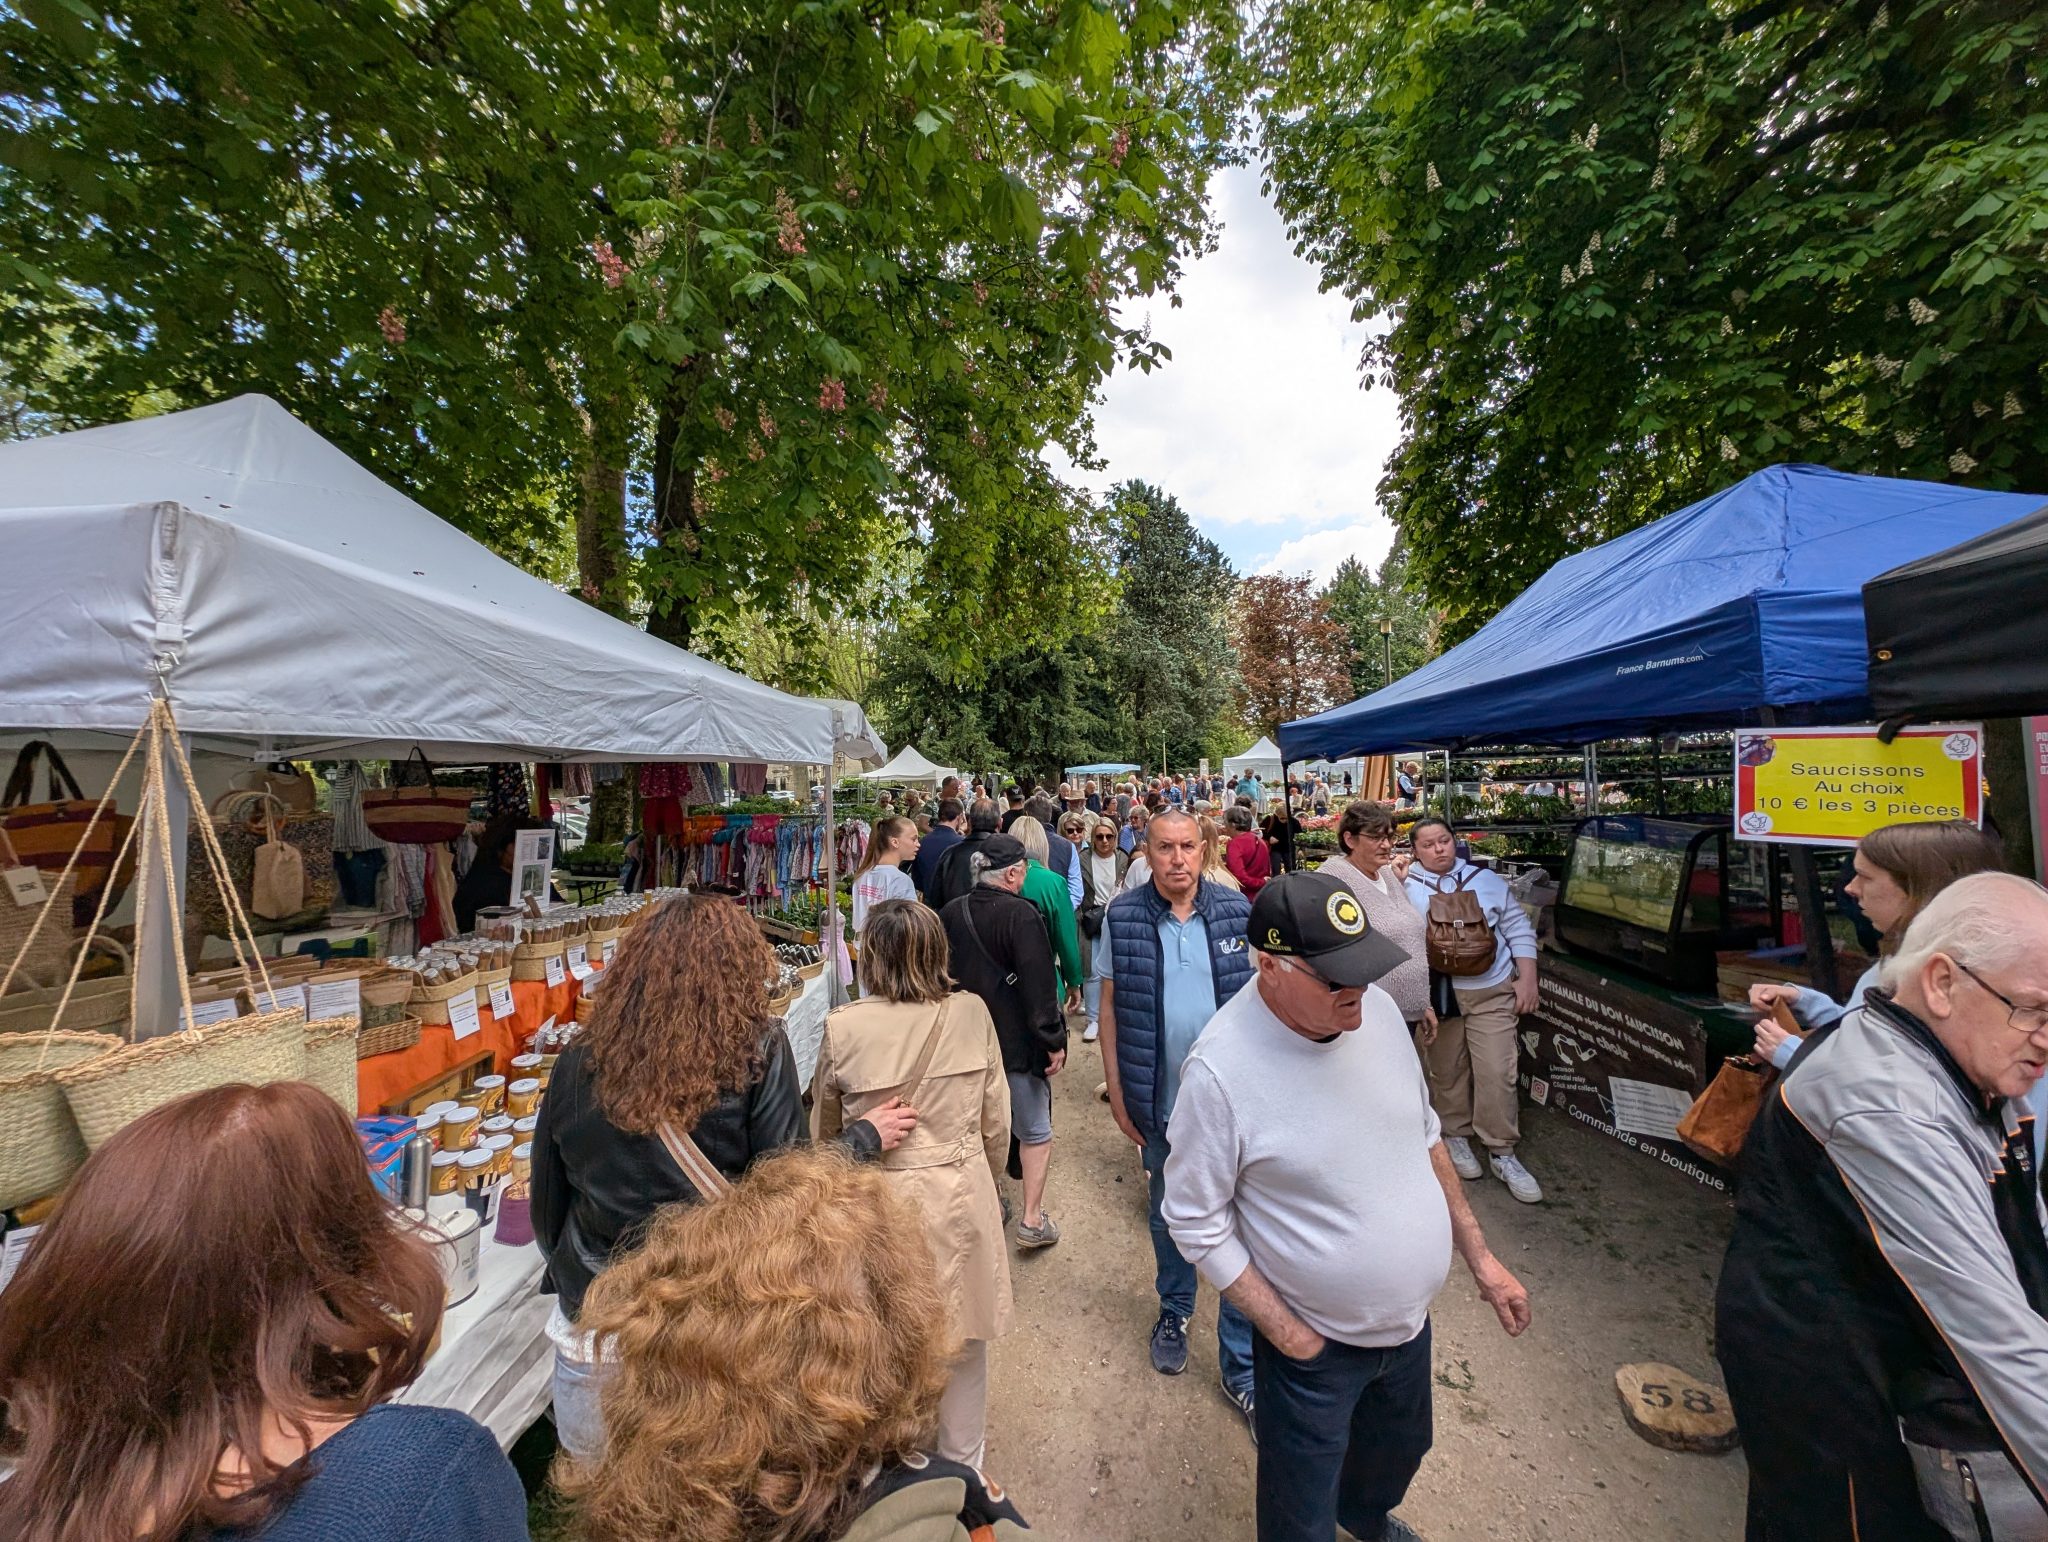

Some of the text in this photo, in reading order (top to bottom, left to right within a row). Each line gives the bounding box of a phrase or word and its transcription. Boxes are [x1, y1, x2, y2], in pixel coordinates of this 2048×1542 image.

[1616, 655, 1704, 676] France Barnums.com
[1791, 762, 1925, 778] Saucissons
[1814, 781, 1904, 795] Au choix
[1758, 797, 1961, 817] 10 € les 3 pièces
[1539, 977, 1584, 1006] ARTISANALE
[1585, 996, 1599, 1013] DU
[1600, 1003, 1623, 1024] BON
[1624, 1014, 1685, 1051] SAUCISSON
[1596, 1037, 1631, 1061] choix
[1550, 1073, 1572, 1082] mondial
[1566, 1082, 1577, 1090] and
[1577, 1083, 1599, 1093] collect
[1568, 1104, 1638, 1147] Commande
[1640, 1142, 1657, 1157] en
[1660, 1150, 1725, 1191] boutique
[1640, 1383, 1716, 1414] 58
